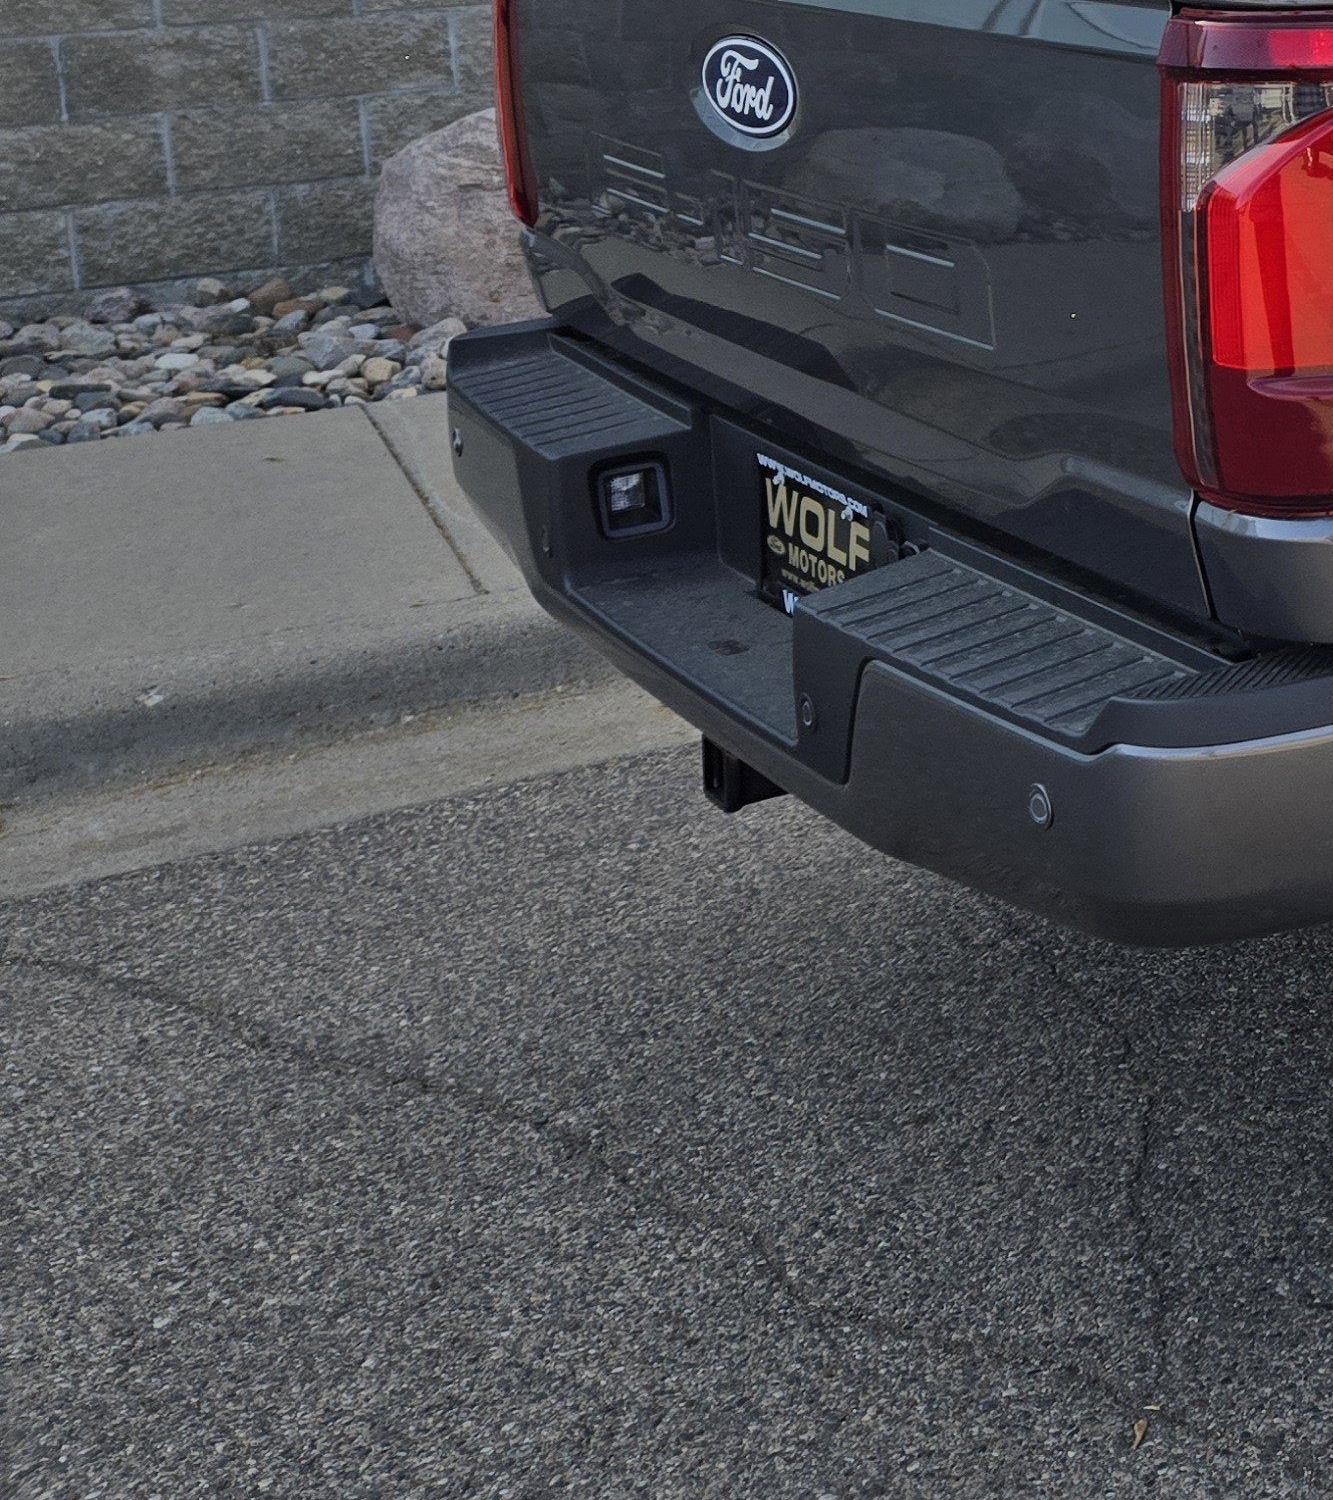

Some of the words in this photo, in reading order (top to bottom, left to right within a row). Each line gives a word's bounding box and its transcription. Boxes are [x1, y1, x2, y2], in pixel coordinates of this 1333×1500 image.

[715, 49, 776, 121] Ford
[765, 477, 870, 572] WOLF
[788, 542, 845, 586] MOTORS
